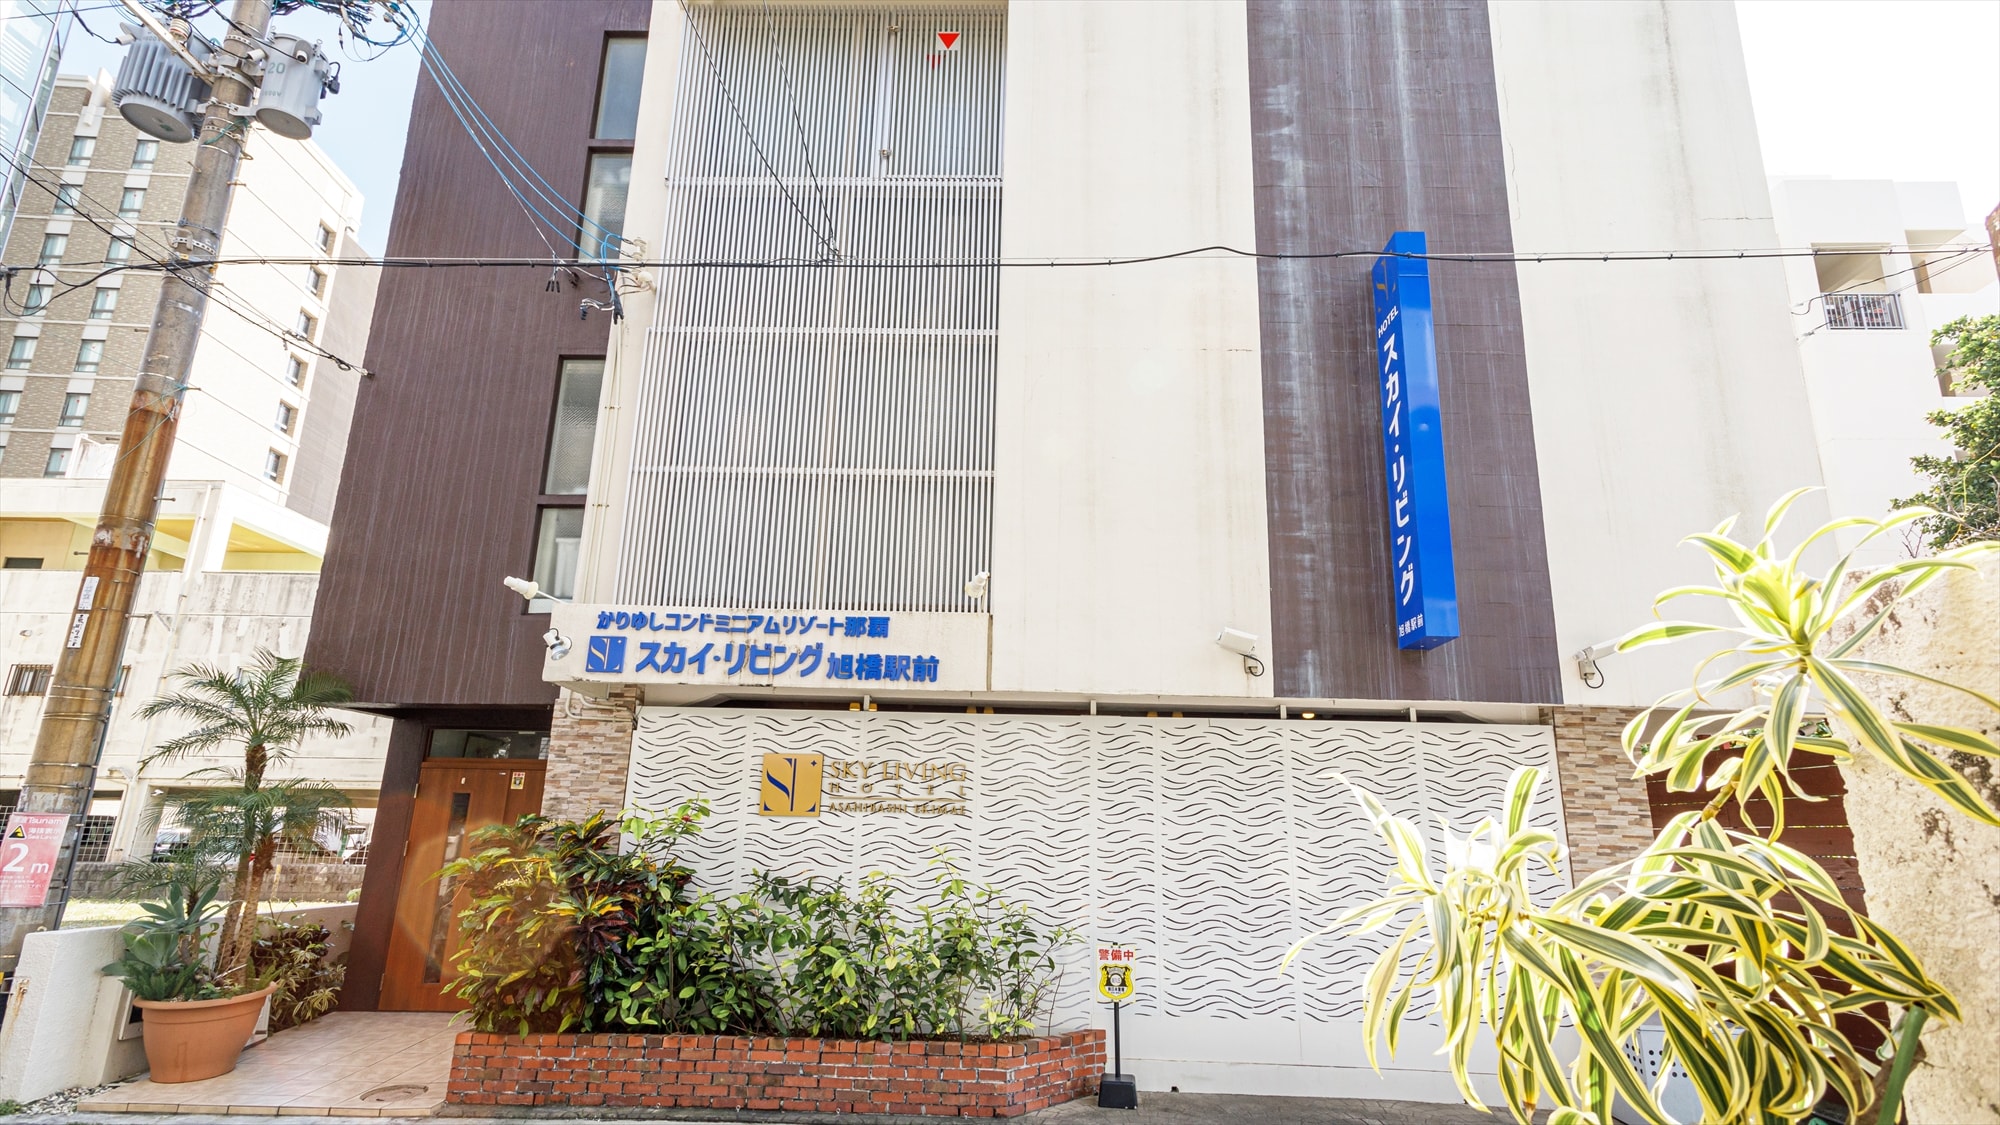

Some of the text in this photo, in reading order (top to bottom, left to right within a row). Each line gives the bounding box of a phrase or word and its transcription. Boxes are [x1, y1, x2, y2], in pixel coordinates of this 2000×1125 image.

[267, 62, 286, 74] 20
[1377, 305, 1399, 338] HOTEL
[1383, 333, 1414, 605] スカイ・リビング
[597, 610, 891, 638] かりゆしコンドミニアムリゾート那覇
[1398, 612, 1424, 638] 旭橋駅前
[826, 652, 941, 683] 旭橋駅前
[830, 760, 967, 782] SKY LIVING
[829, 782, 967, 796] HOTEL
[29, 816, 65, 825] Tsunami
[829, 802, 967, 815] ASAHIBASHI EKIMAE
[2, 843, 49, 874] 2 m
[1098, 948, 1134, 961] 警備中
